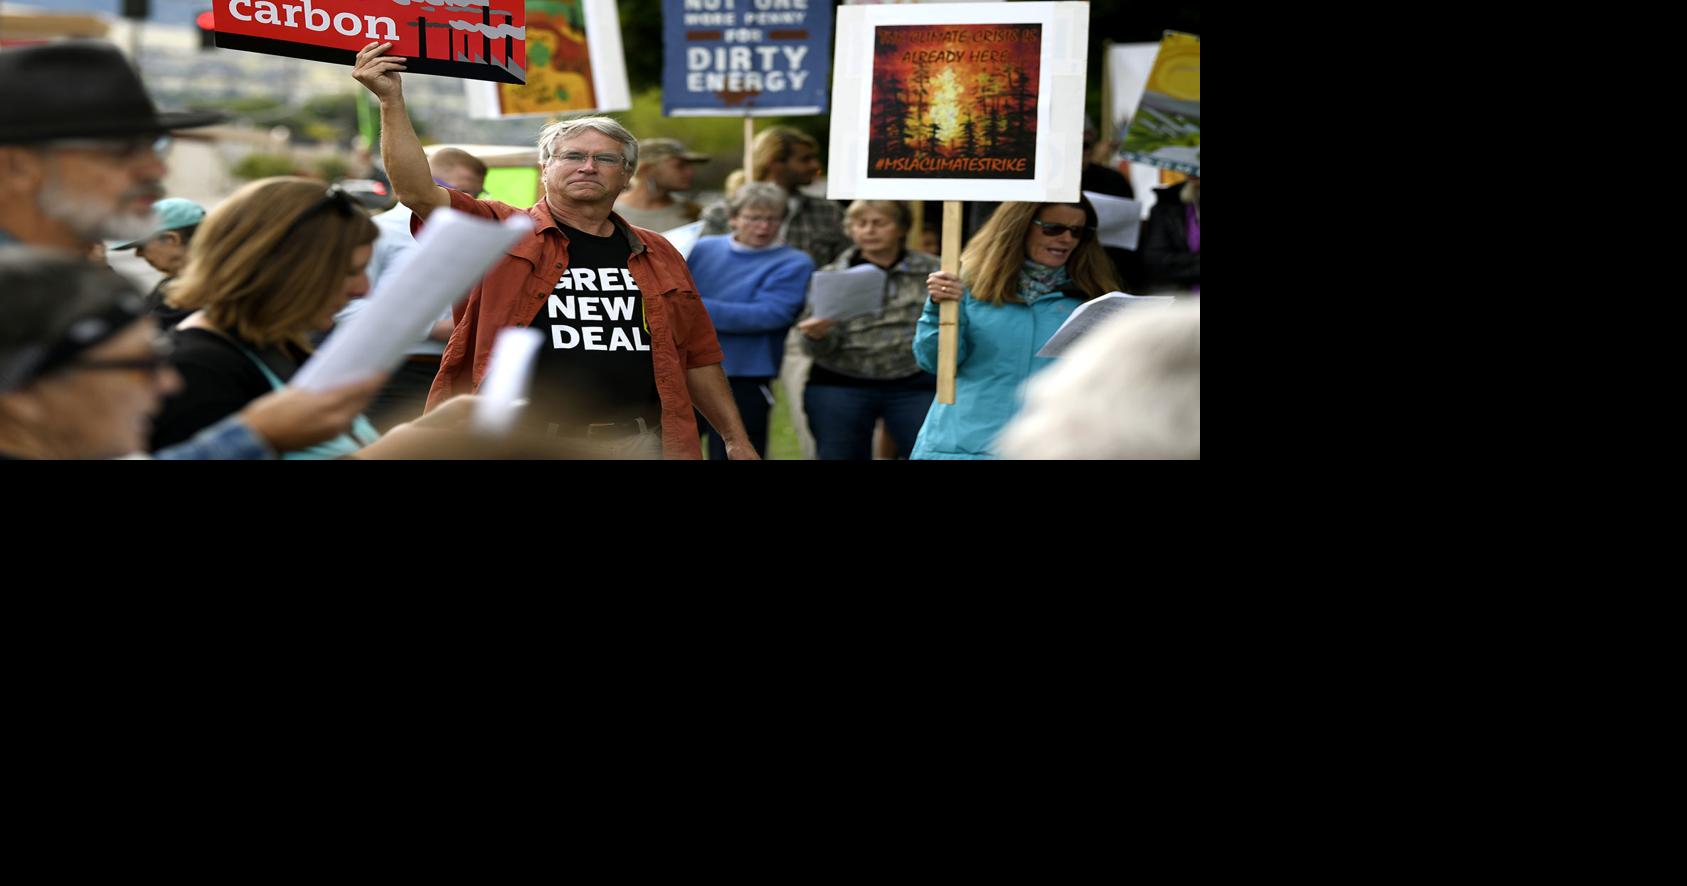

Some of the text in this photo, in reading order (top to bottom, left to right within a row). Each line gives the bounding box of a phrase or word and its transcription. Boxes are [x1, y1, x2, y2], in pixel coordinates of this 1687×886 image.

[228, 0, 400, 41] carbon
[684, 12, 807, 26] MORE PENNY
[723, 28, 763, 43] FOR
[910, 30, 968, 43] CLIMATE
[972, 29, 1018, 43] CRISIS
[687, 46, 808, 71] DIRTY
[902, 50, 1009, 64] ALREADY HERE
[687, 70, 808, 92] ENERGY
[875, 157, 1027, 172] #MSLACLIMATESTRIKE
[547, 294, 636, 321] NEW
[551, 324, 651, 351] DEAL
